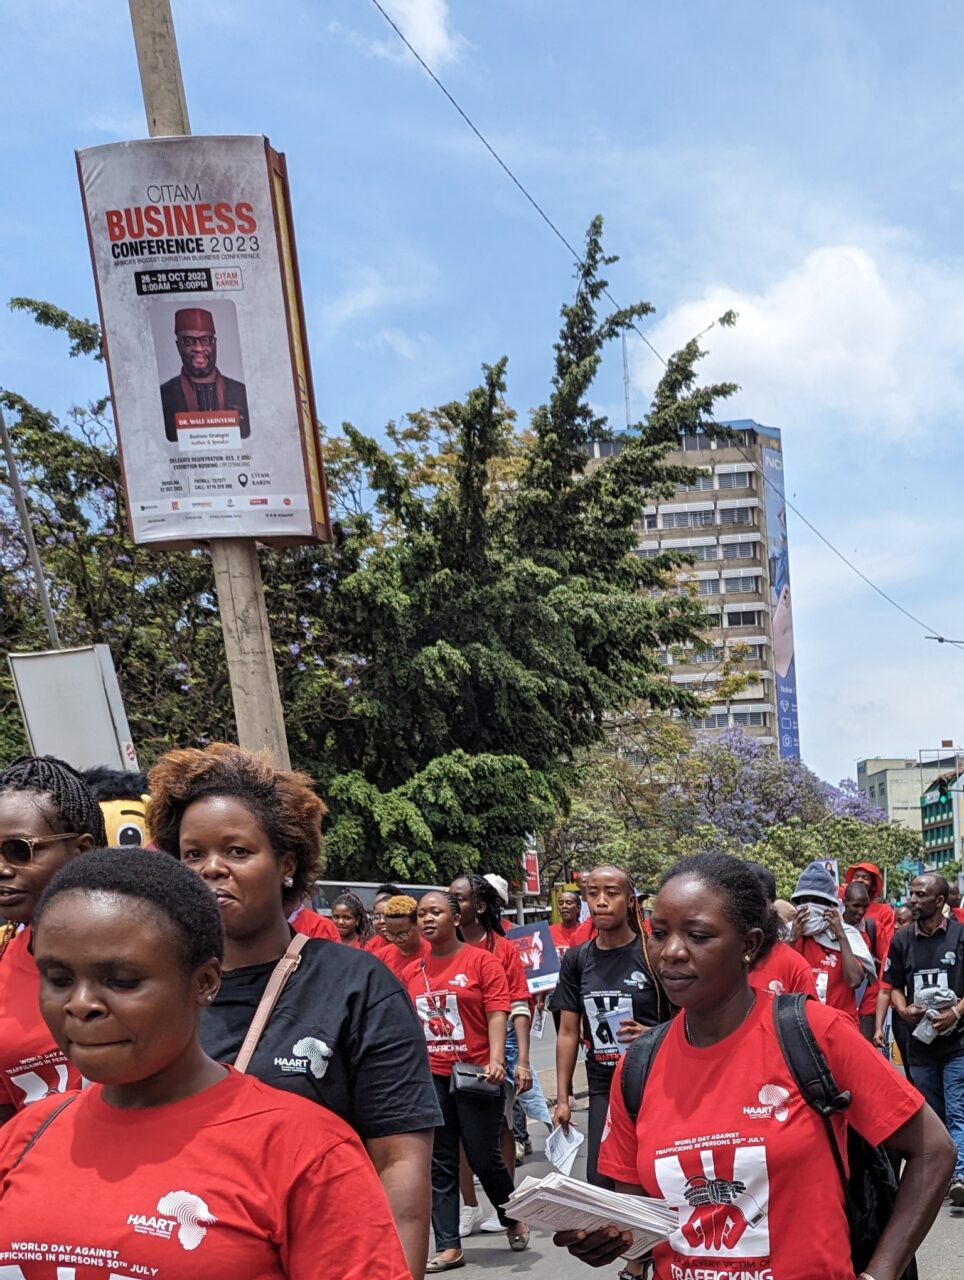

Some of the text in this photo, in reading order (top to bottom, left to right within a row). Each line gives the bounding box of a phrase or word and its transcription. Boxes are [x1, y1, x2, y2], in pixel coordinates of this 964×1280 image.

[147, 184, 202, 203] CITAM
[105, 203, 257, 241] BUSINESS
[111, 236, 260, 259] CONFERENCE 2023
[161, 255, 191, 263] CHRISTIAN
[192, 254, 220, 262] BUSINESS
[158, 273, 167, 282] 28
[168, 272, 186, 281] OCT
[187, 271, 206, 281] 2023
[215, 272, 238, 280] CITAM
[142, 283, 171, 292] 8:00AM
[179, 281, 208, 290] 5:00PM
[274, 1058, 308, 1067] HAART
[743, 1106, 773, 1115] HAART
[674, 1137, 696, 1146] WORLD
[711, 1132, 739, 1140] AGAINST
[656, 1144, 693, 1155] TRAFFICKING
[702, 1139, 731, 1148] PERSONS
[127, 1214, 177, 1232] HAART
[11, 1242, 119, 1259] WORLD DAY AGAINST
[0, 1252, 43, 1261] FFICKING
[45, 1253, 56, 1262] IN
[58, 1255, 104, 1267] PERSONS
[130, 1264, 159, 1276] JULY
[692, 1259, 719, 1268] EVERY
[724, 1260, 755, 1268] VICTIM
[759, 1258, 773, 1268] OF
